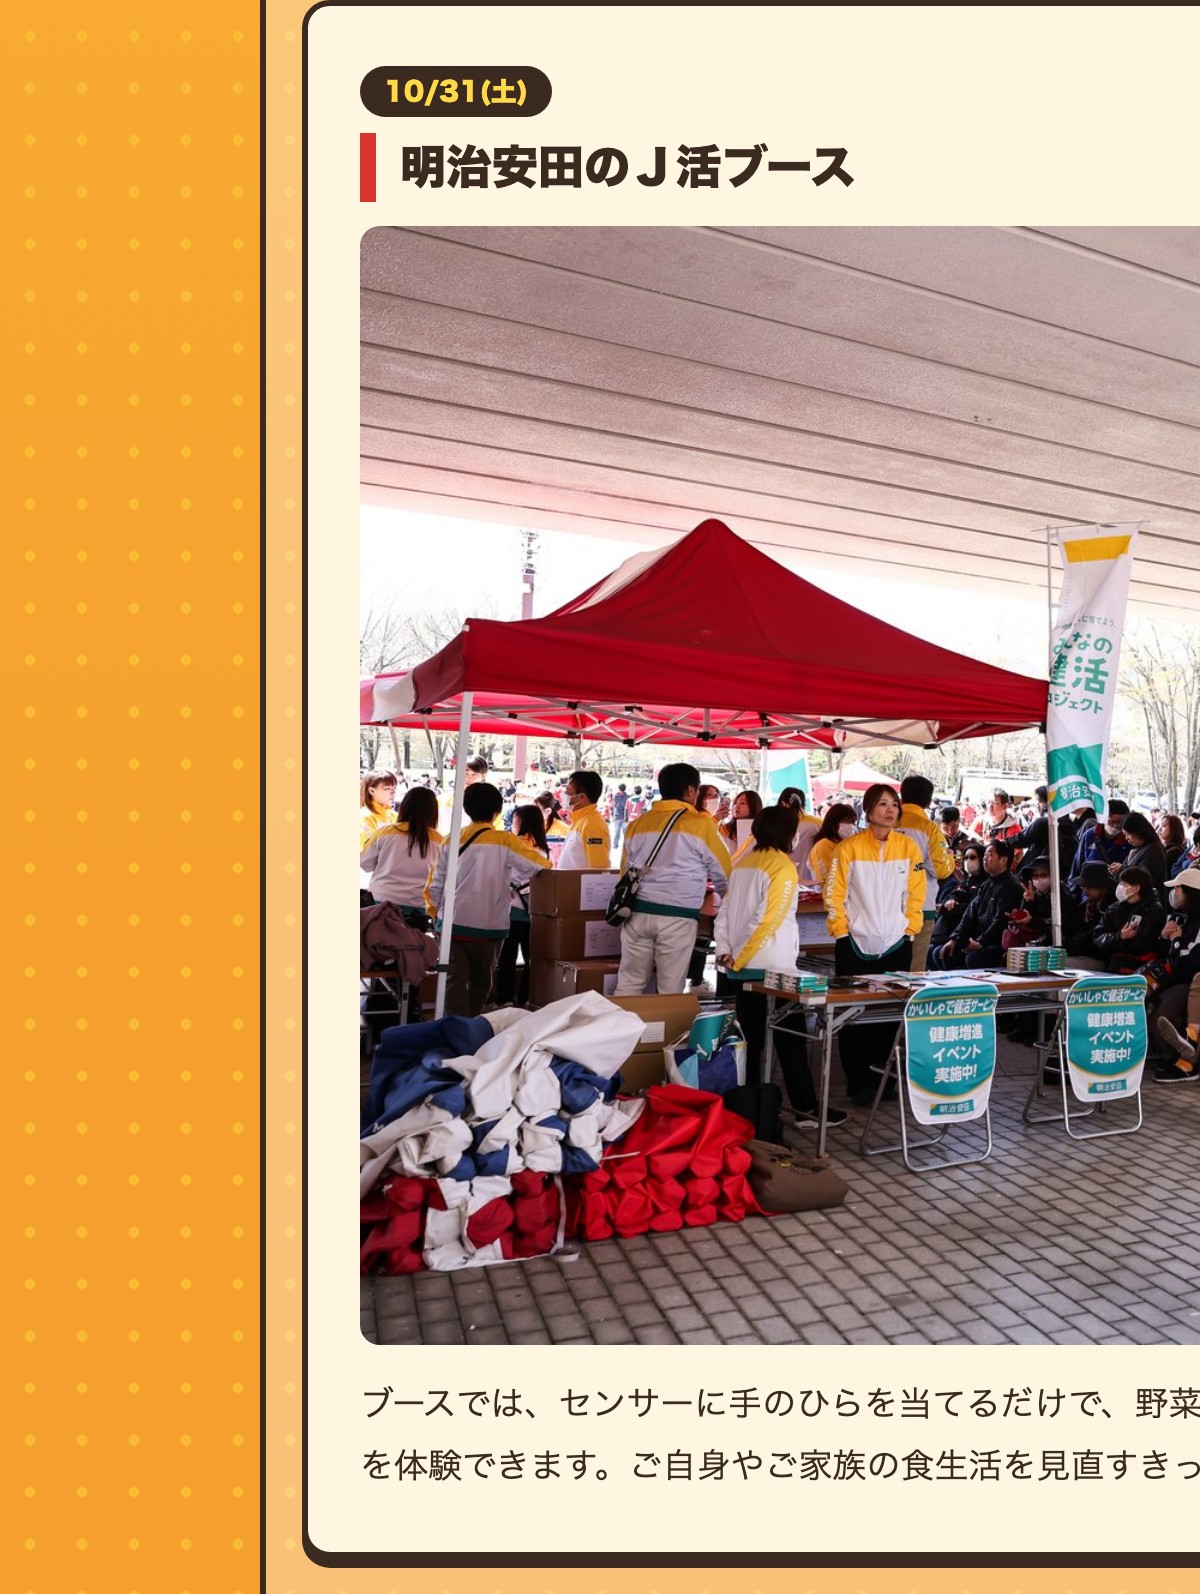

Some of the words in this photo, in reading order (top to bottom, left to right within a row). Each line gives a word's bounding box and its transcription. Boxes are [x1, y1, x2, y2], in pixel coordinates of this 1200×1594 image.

[1086, 1011, 1136, 1028] 健康増進
[929, 1023, 983, 1043] 健康増進
[1088, 1030, 1135, 1045] イベント
[932, 1043, 982, 1062] イベント
